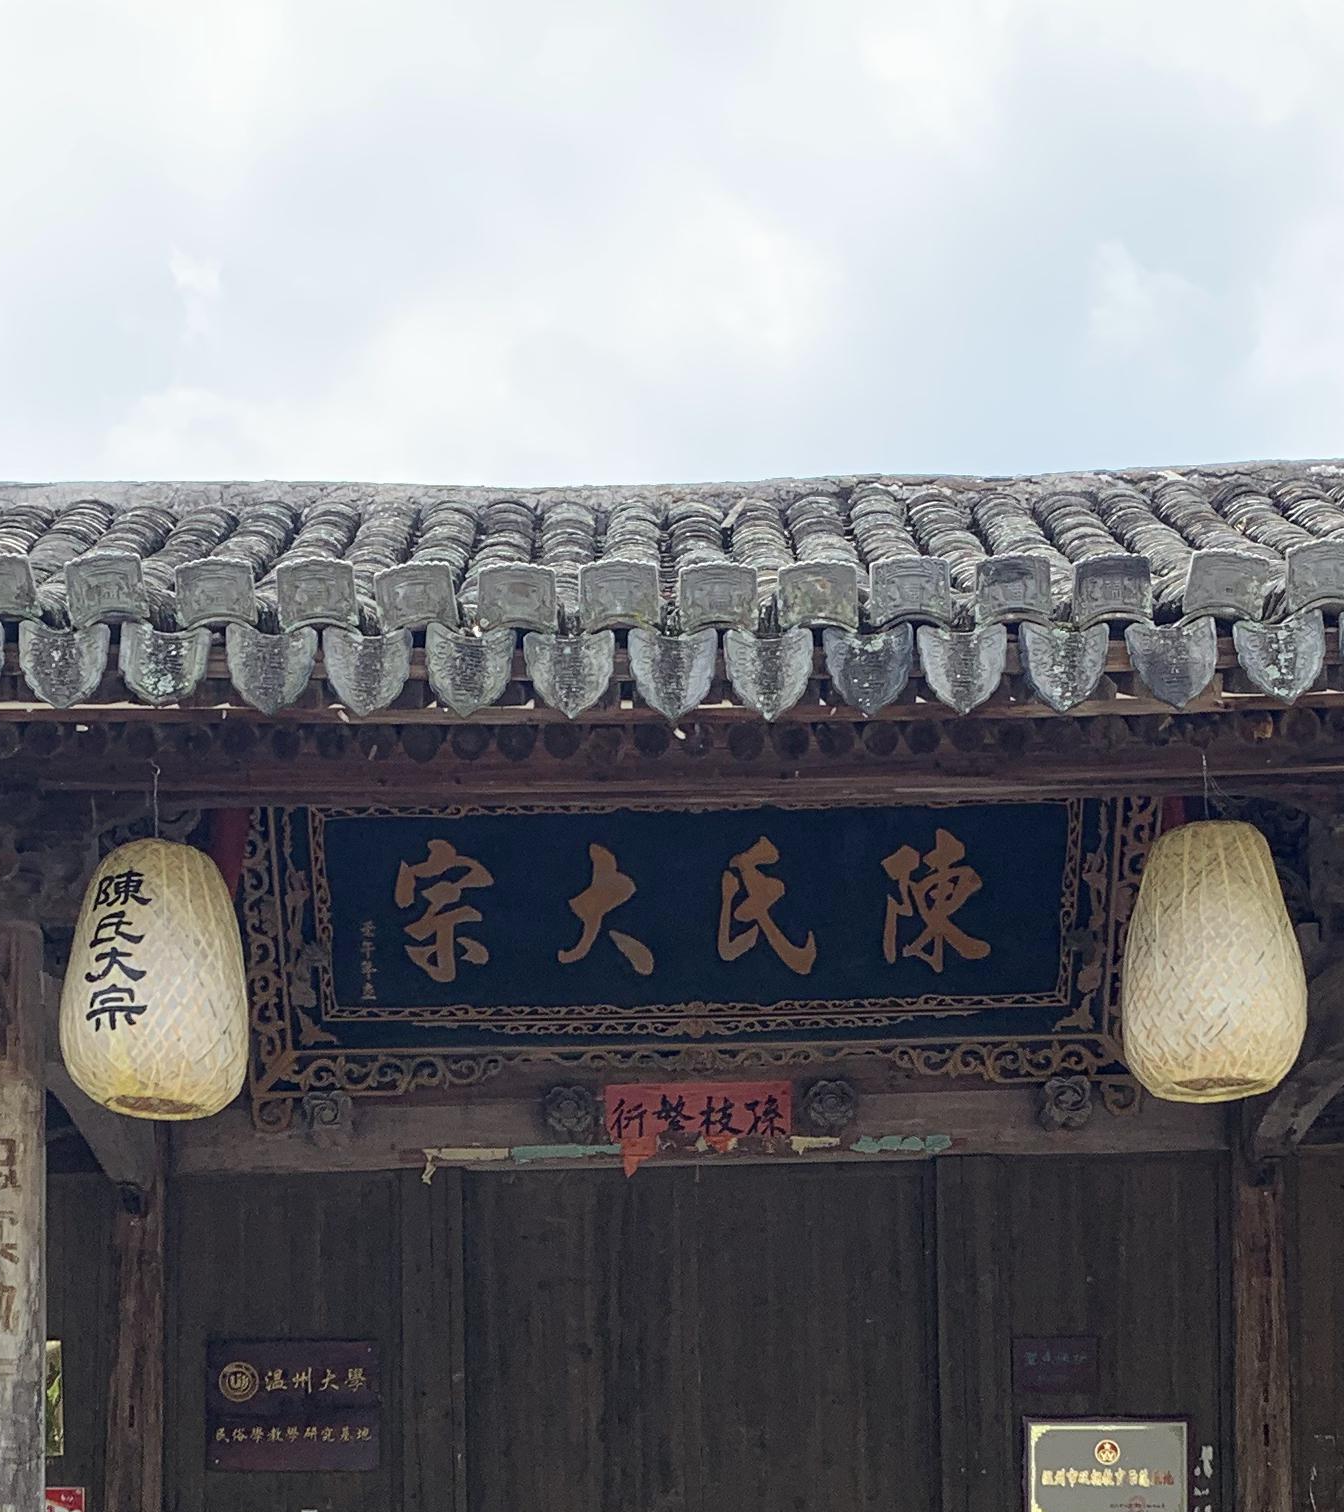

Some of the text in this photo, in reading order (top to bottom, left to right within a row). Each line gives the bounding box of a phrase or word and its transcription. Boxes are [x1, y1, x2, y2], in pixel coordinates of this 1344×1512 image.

[85, 870, 152, 1032] 陳氏大宗
[396, 828, 992, 983] 陳氏大宗
